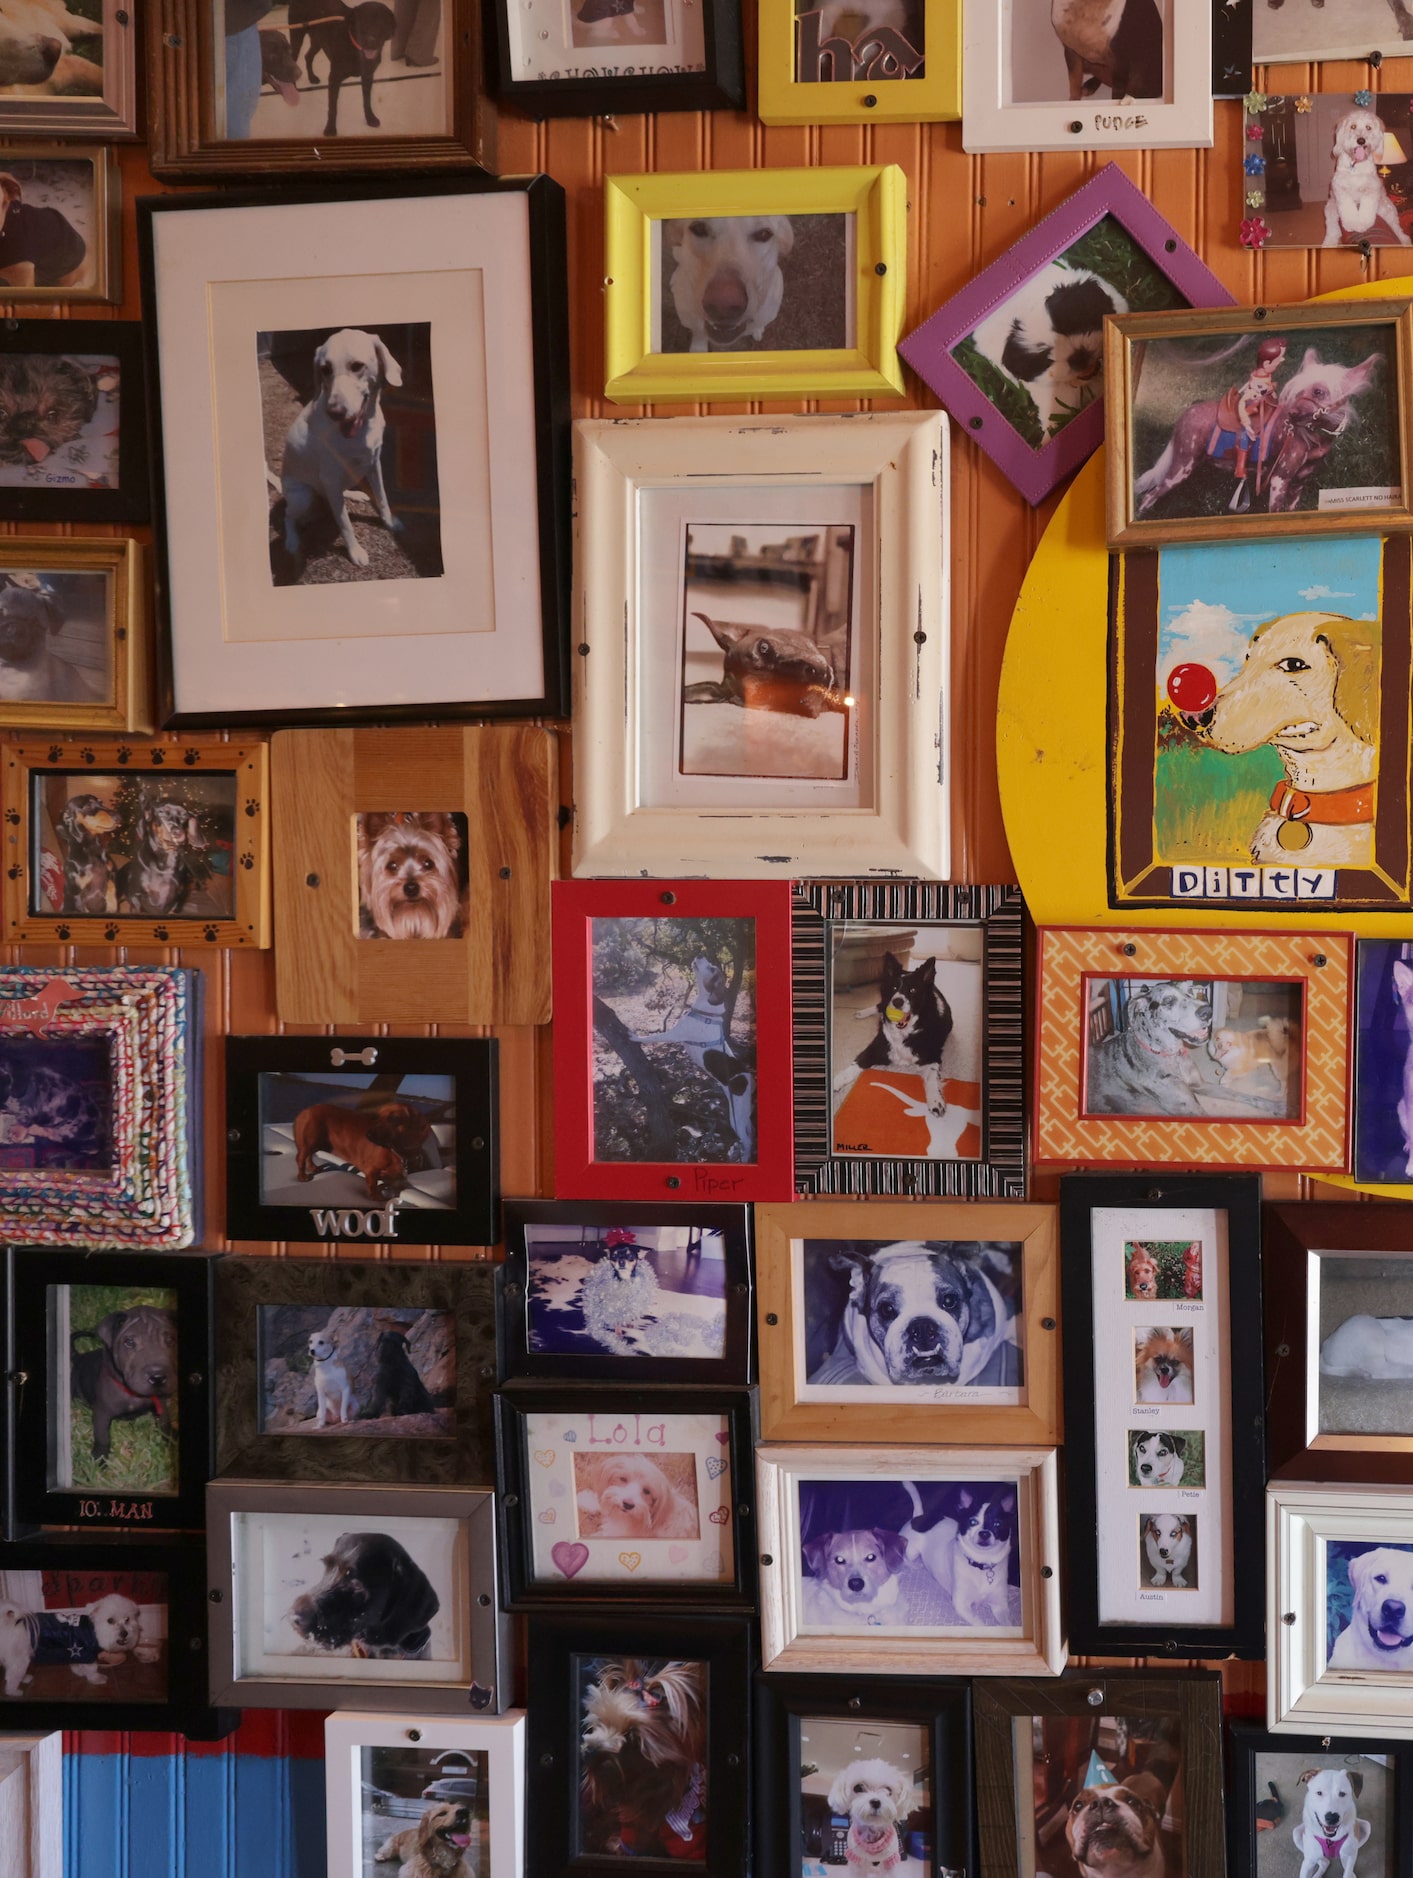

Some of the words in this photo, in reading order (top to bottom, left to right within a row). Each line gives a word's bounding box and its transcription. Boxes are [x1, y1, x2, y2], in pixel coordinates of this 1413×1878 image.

[1094, 114, 1148, 131] PUDGE
[46, 473, 75, 483] Gizmo
[694, 1167, 744, 1195] Piper
[309, 1197, 402, 1237] woof
[1176, 1304, 1204, 1312] Morgan
[1132, 1407, 1160, 1416] Stanley
[588, 1414, 666, 1447] Lola
[1140, 1593, 1164, 1601] Austin
